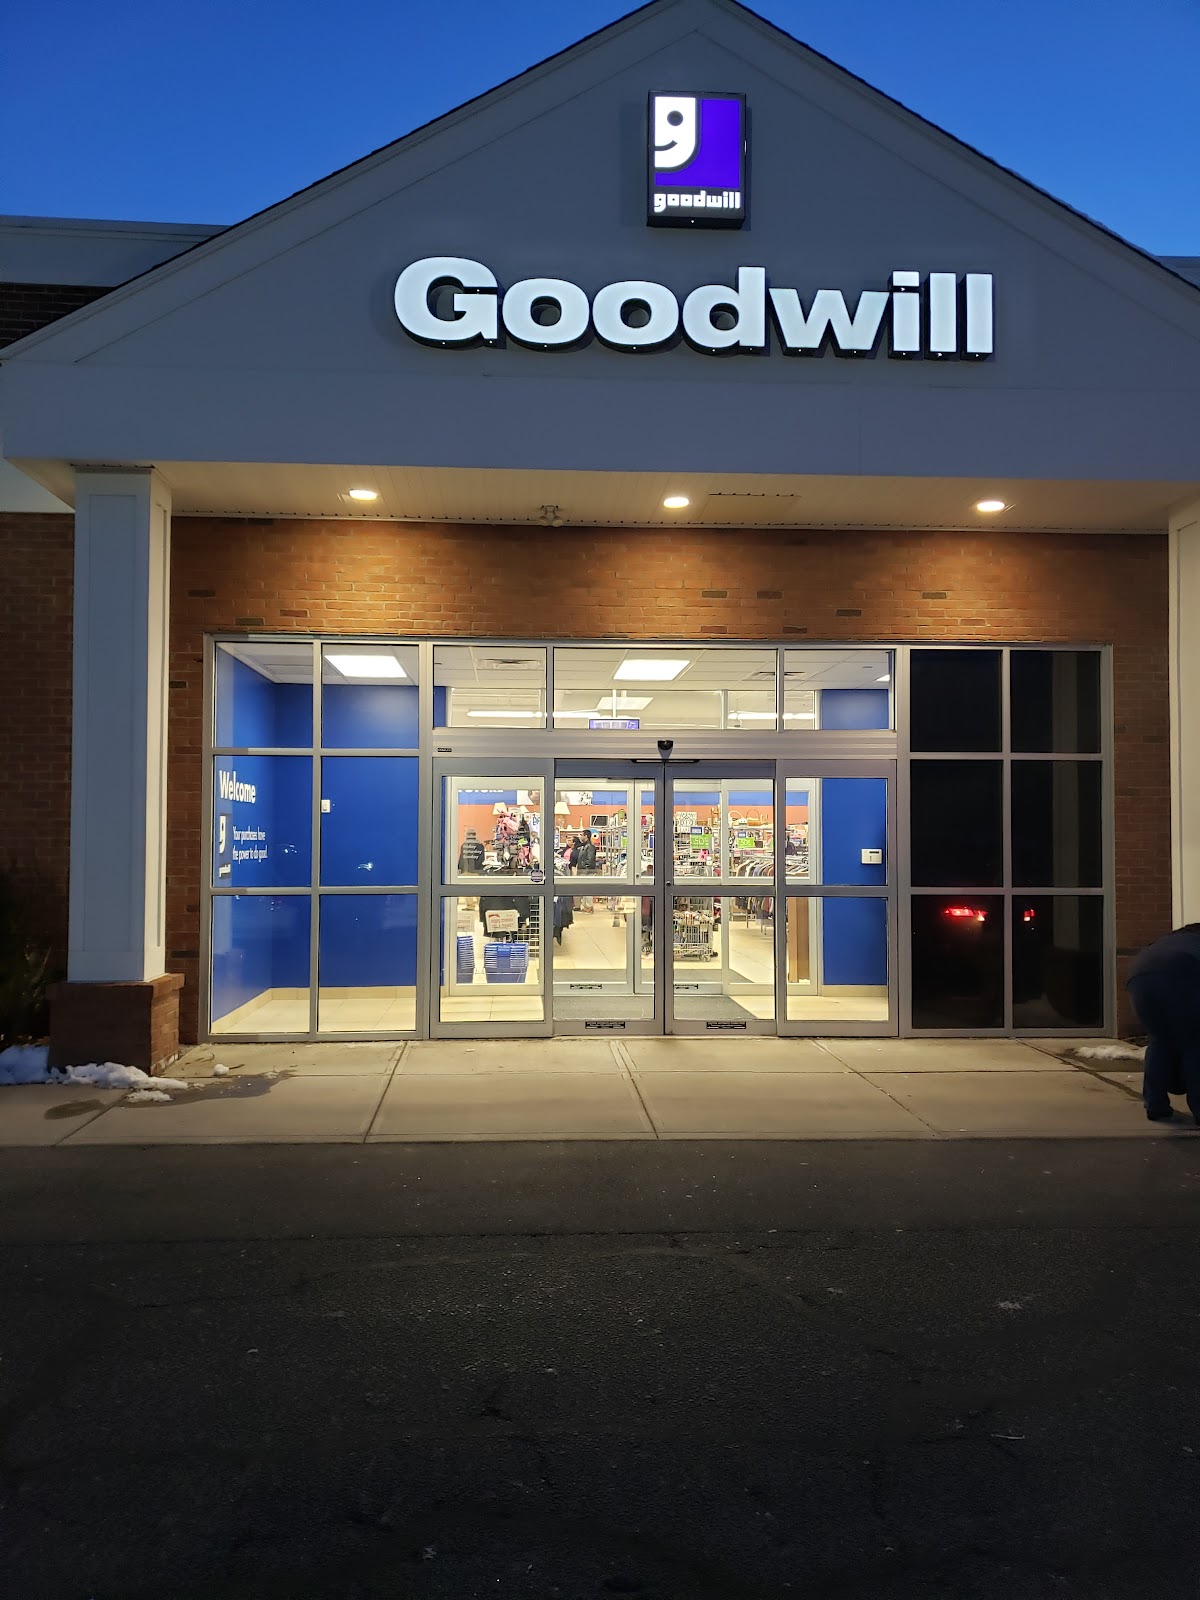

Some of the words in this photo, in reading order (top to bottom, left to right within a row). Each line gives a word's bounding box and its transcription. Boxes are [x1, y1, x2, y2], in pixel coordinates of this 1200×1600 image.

[653, 190, 741, 213] goodwill
[394, 256, 993, 354] Goodwill
[219, 770, 256, 803] Welcome
[232, 825, 241, 841] Your
[257, 826, 266, 841] have
[238, 849, 250, 865] power
